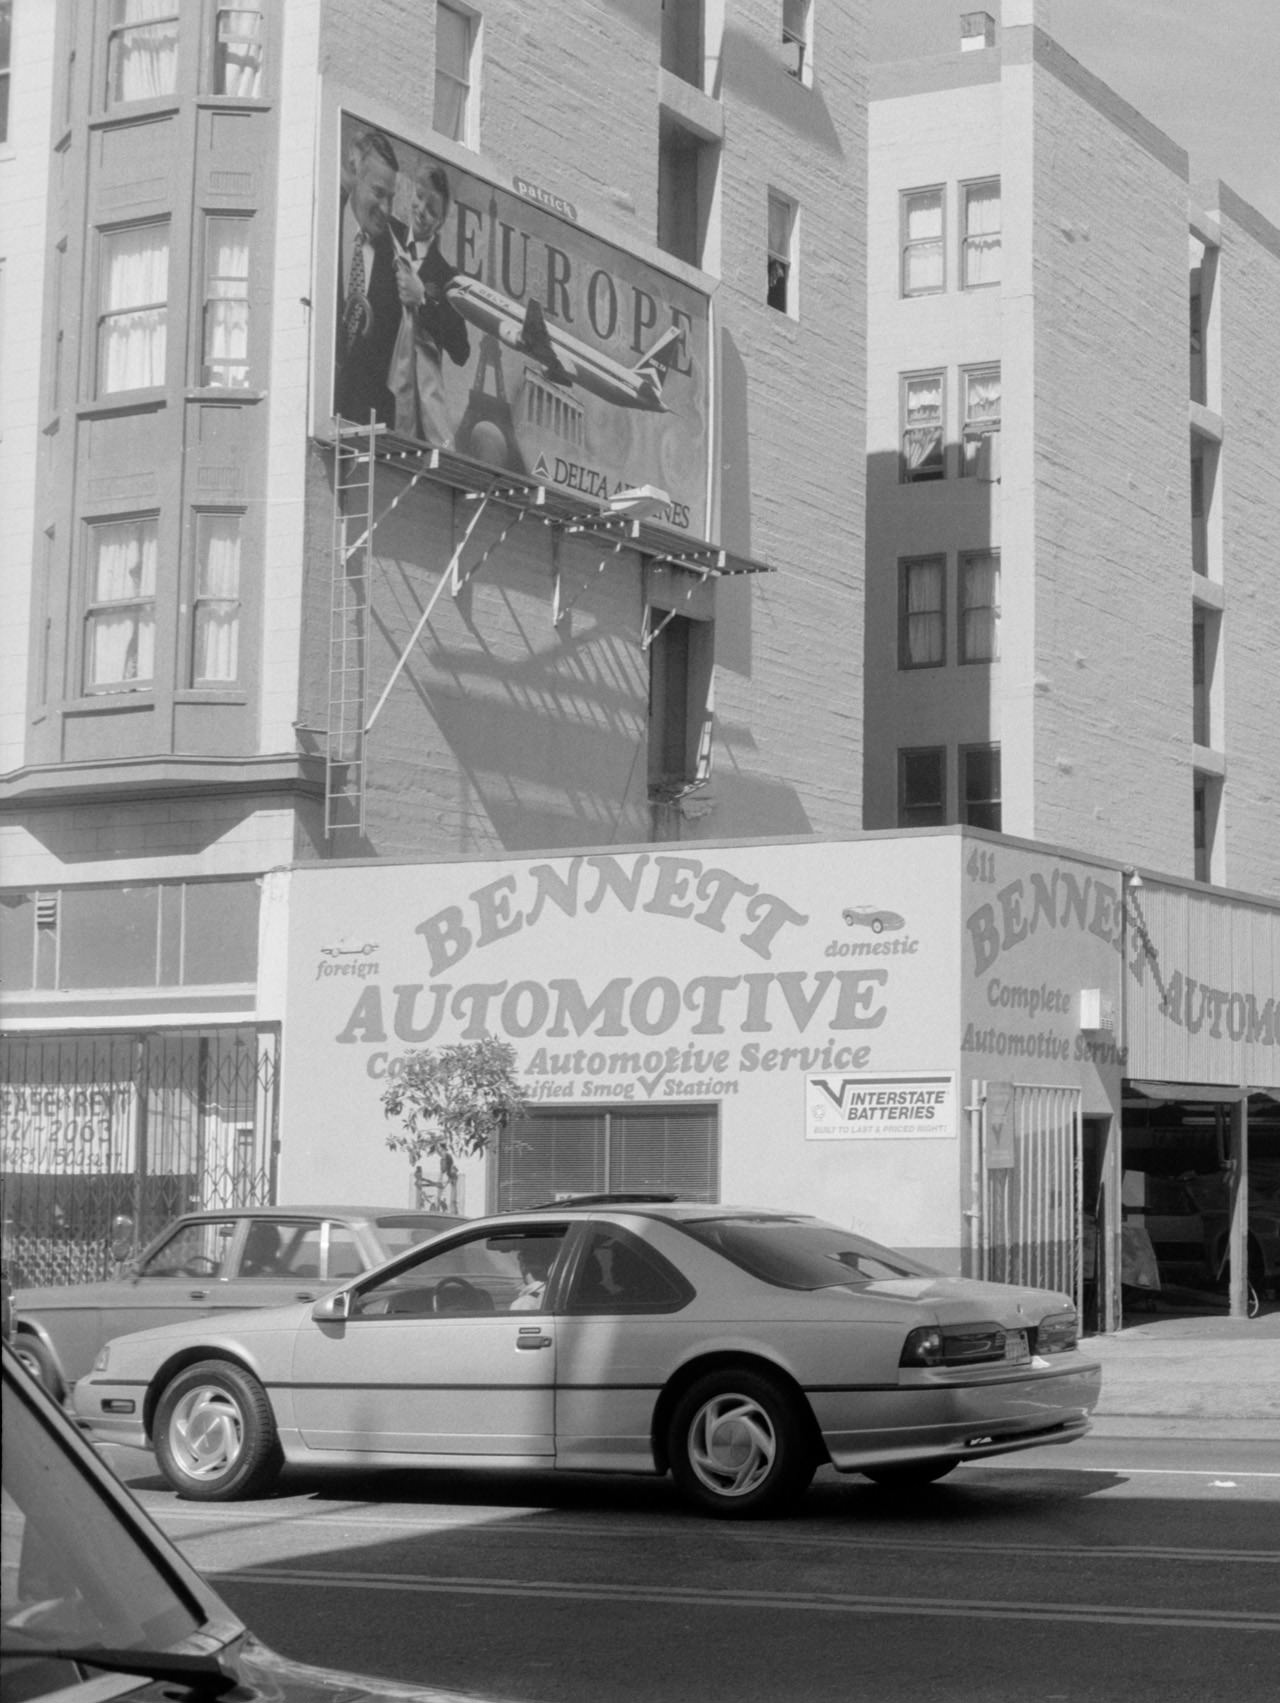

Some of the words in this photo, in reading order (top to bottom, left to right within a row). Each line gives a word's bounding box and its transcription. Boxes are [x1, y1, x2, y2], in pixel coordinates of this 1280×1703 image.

[517, 180, 575, 220] patrick
[454, 199, 693, 378] EUROPE
[553, 457, 609, 500] DELTA
[967, 848, 997, 884] 411
[415, 854, 809, 976] BENNETT
[824, 936, 919, 958] domestic
[315, 957, 380, 981] foreign
[335, 968, 889, 1045] AUTOMOTIVE
[986, 978, 1071, 1018] Complete
[523, 1042, 730, 1077] Automotive
[738, 1039, 871, 1073] Service
[961, 1022, 1070, 1062] Automotive
[581, 1079, 636, 1100] Smog
[663, 1077, 740, 1097] Station
[850, 1090, 947, 1106] INTERSTATE
[847, 1106, 936, 1121] BATTERIES
